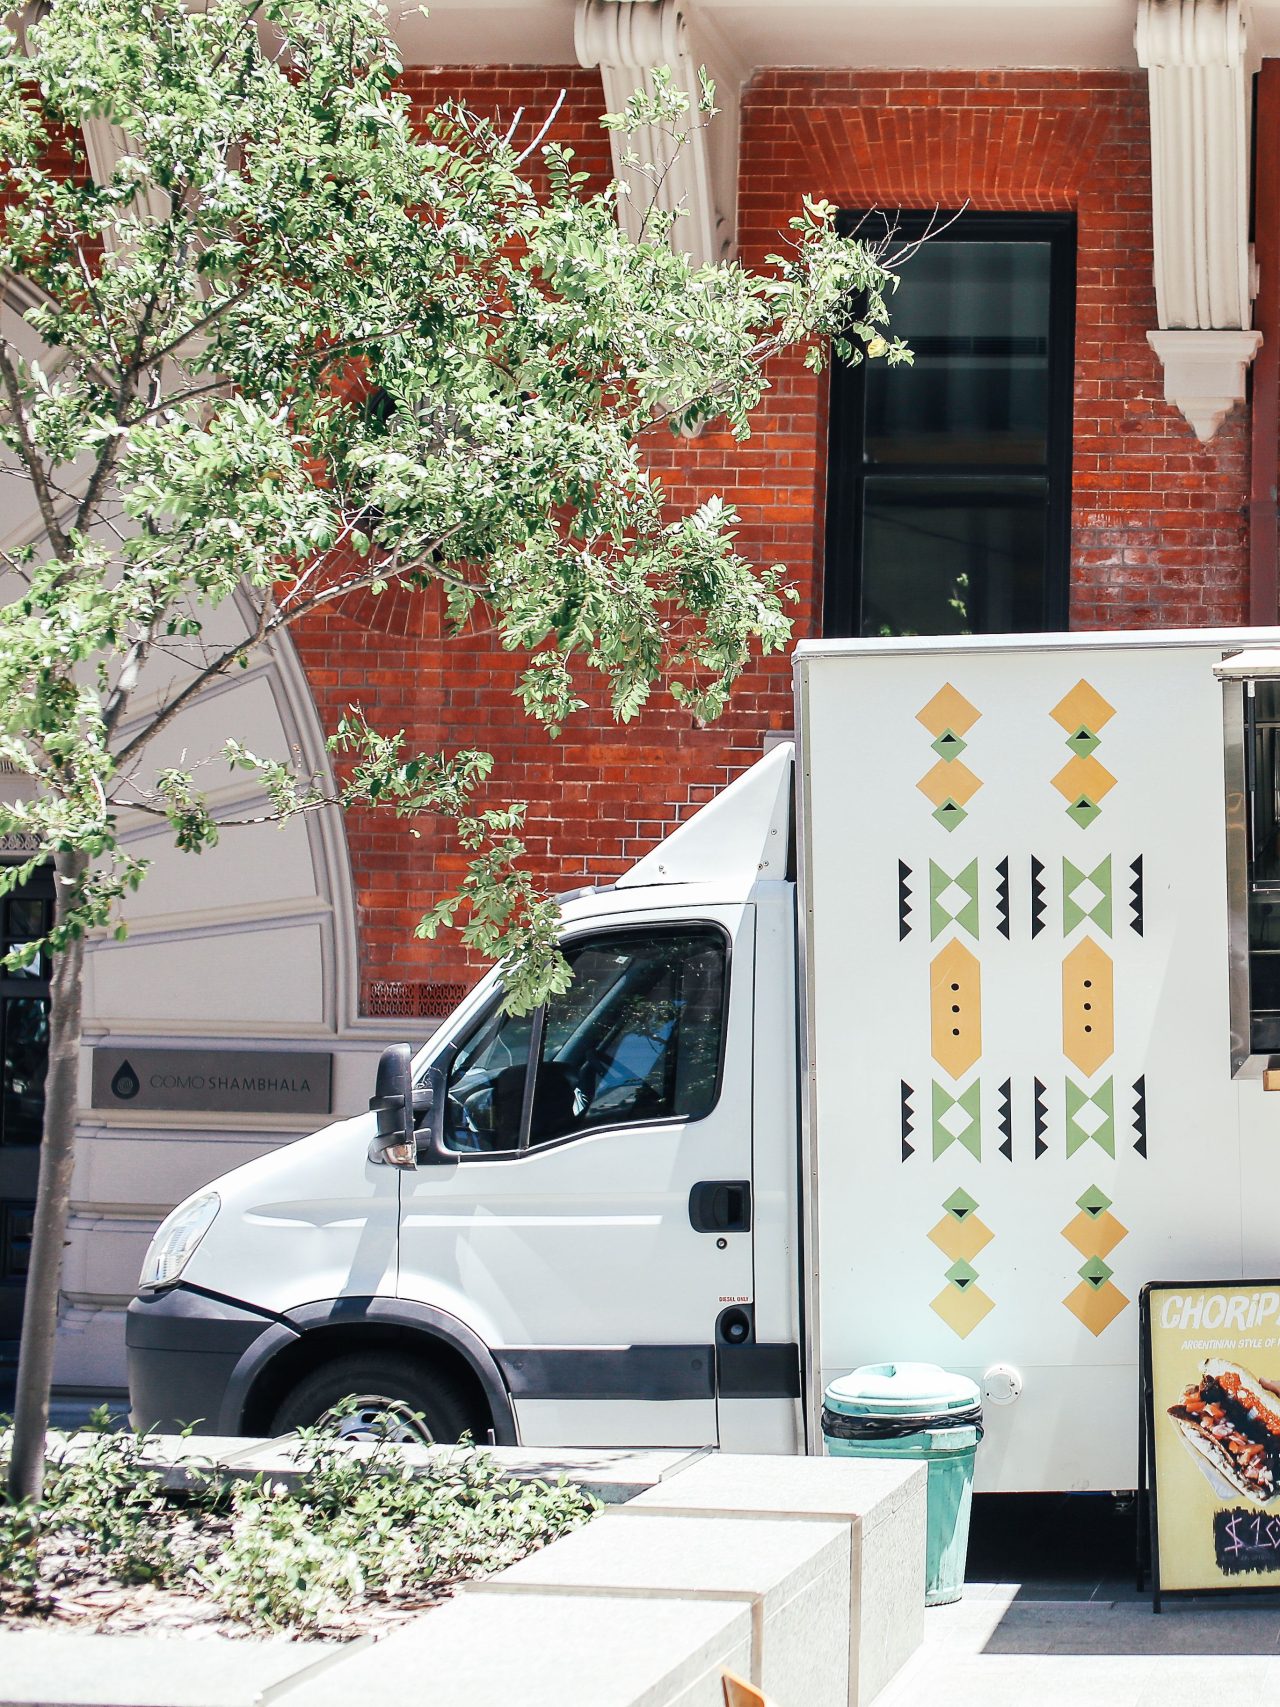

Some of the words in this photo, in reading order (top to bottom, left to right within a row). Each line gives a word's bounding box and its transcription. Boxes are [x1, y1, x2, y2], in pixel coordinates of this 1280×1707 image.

[150, 1074, 205, 1090] COMO
[208, 1078, 312, 1093] SHAMBHALA
[1238, 1337, 1263, 1349] STYLE
[1264, 1337, 1277, 1348] OF
